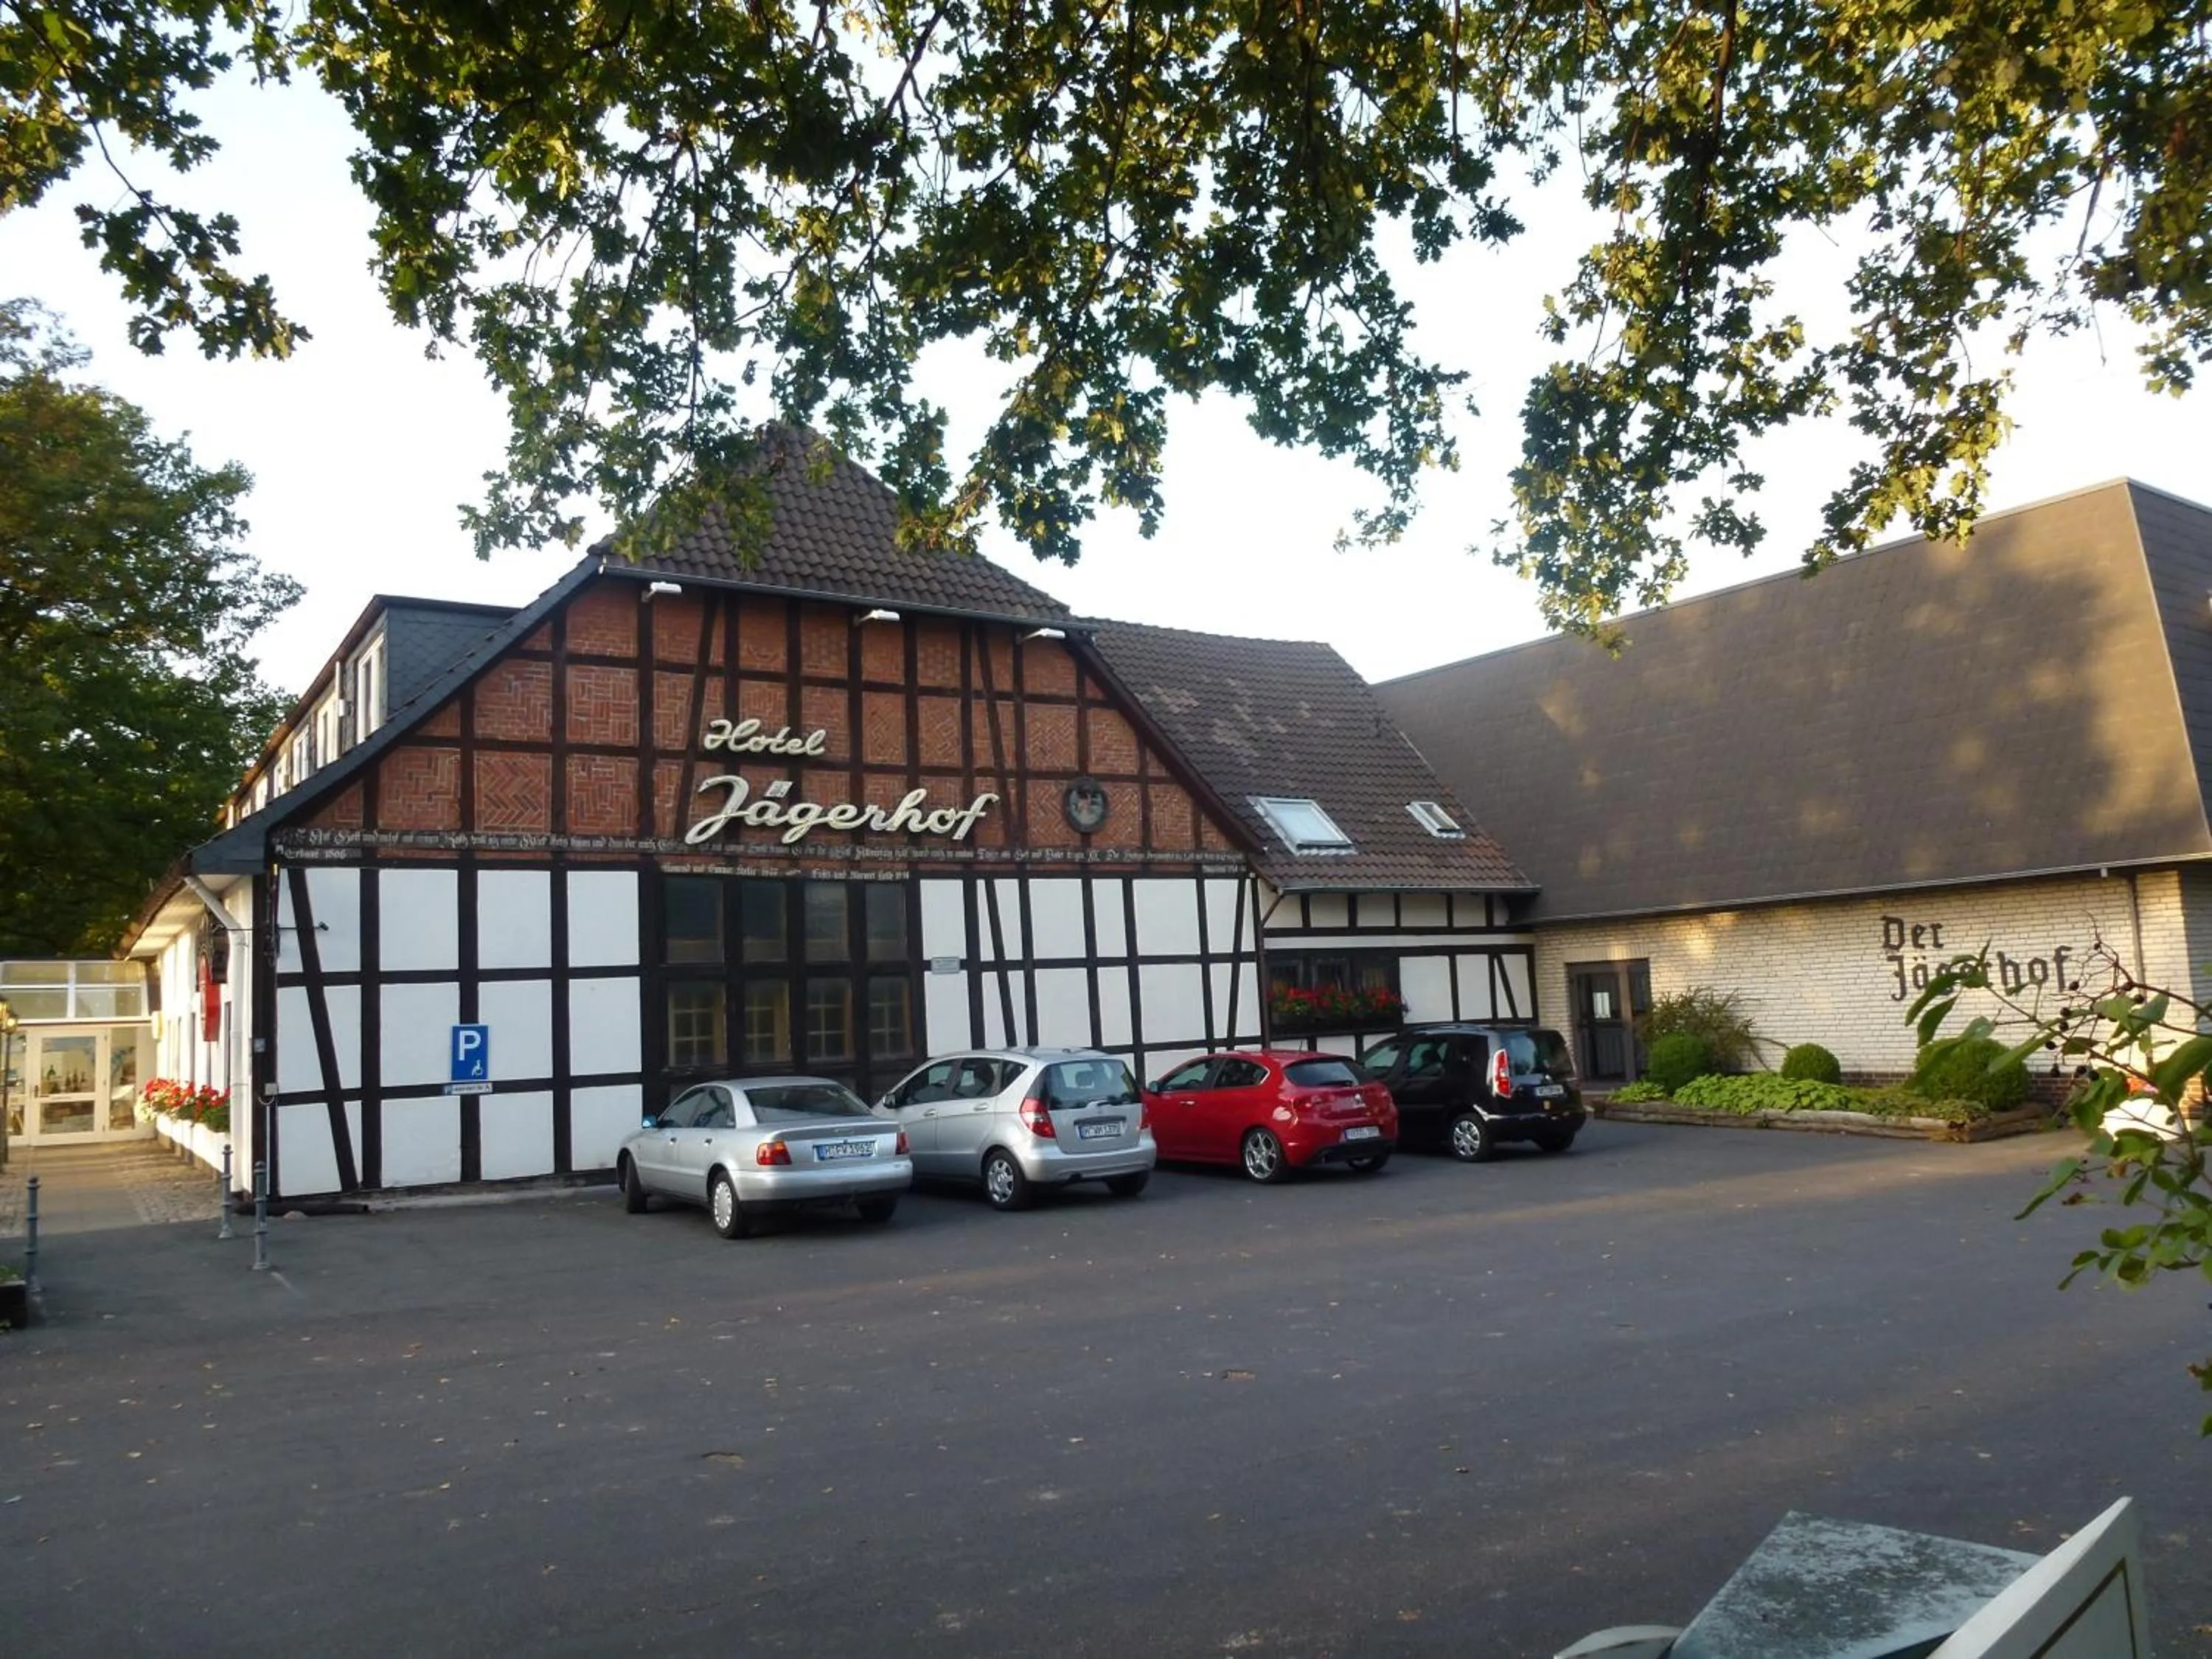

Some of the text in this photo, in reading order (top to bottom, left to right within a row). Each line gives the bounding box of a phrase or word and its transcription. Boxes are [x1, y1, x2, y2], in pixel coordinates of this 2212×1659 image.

[704, 719, 827, 757] Hotel
[684, 775, 1000, 846] Jägerhof
[1882, 916, 1944, 950] Der
[459, 1030, 481, 1061] P
